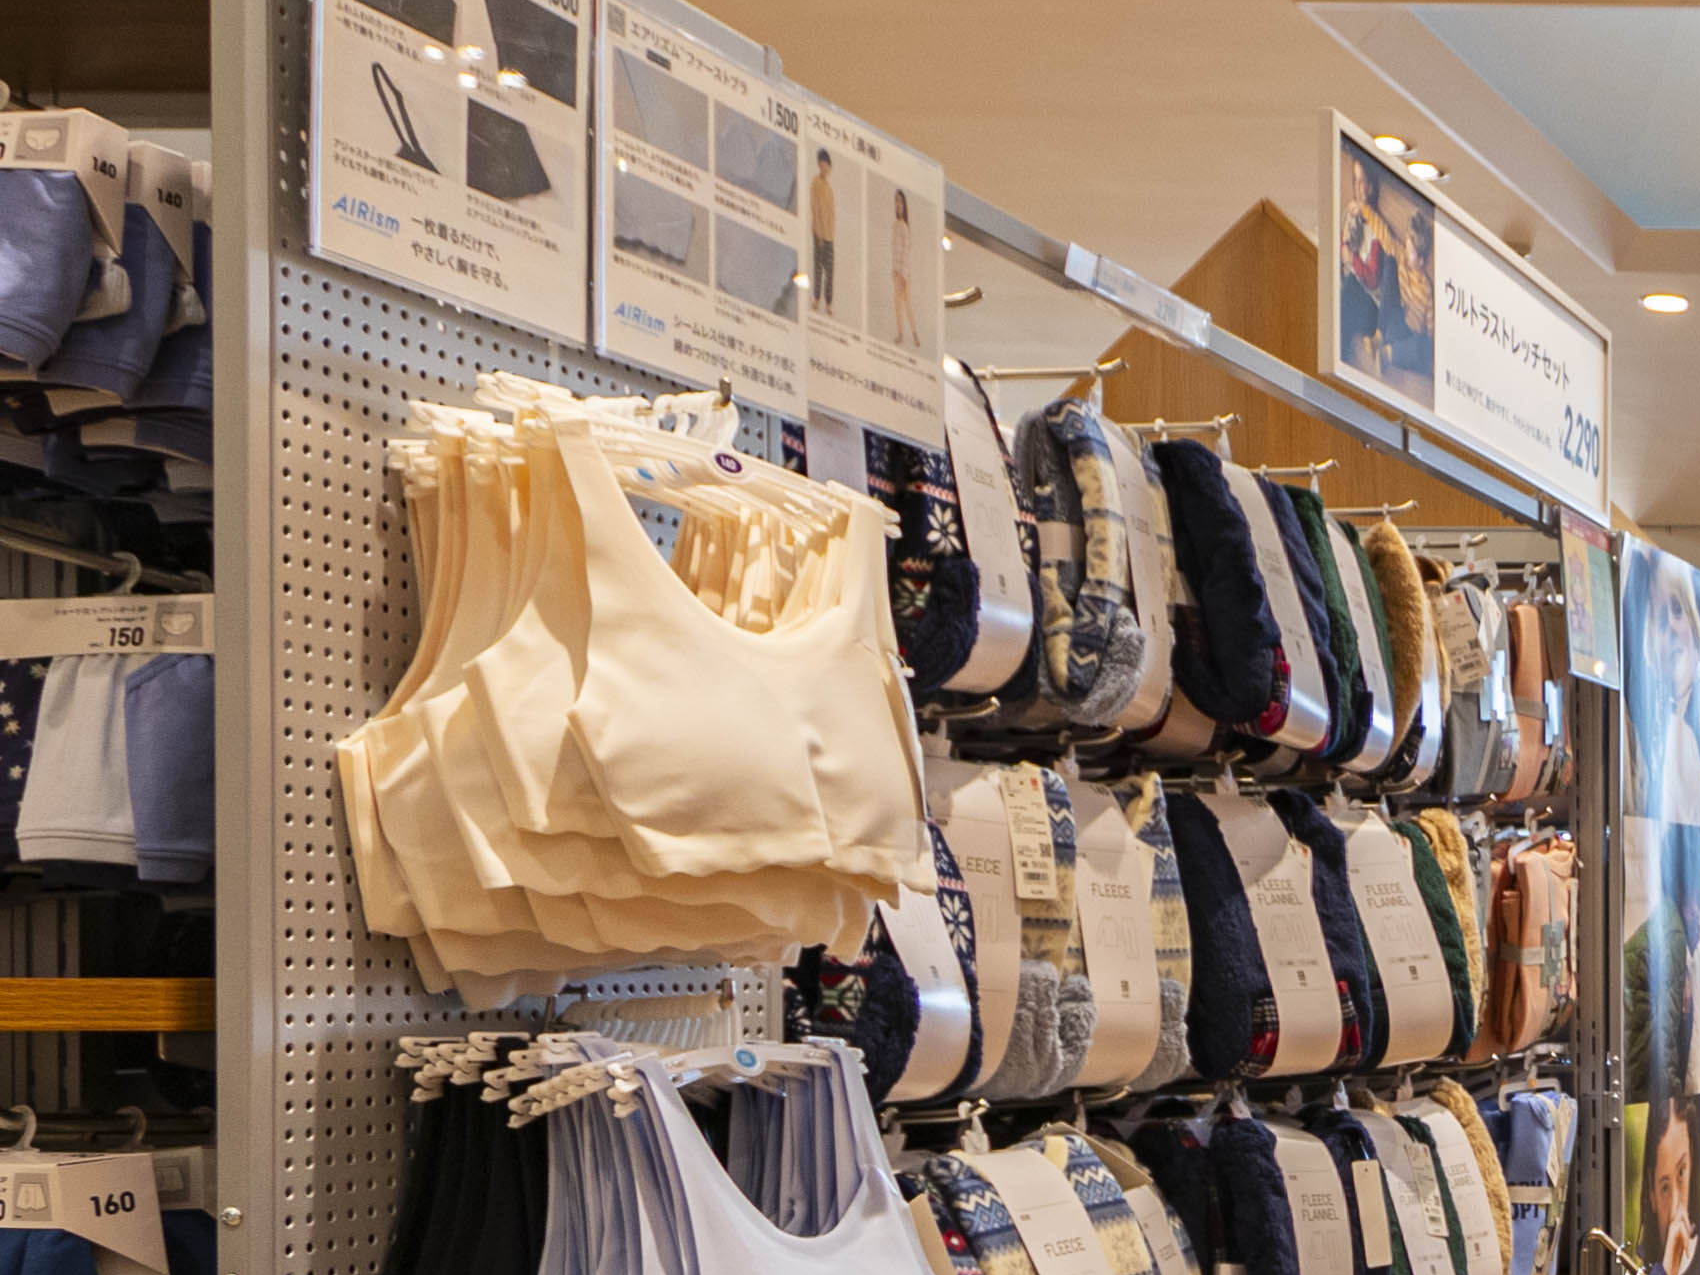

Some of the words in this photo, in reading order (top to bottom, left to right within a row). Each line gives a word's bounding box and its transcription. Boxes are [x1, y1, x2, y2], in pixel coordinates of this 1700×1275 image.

[92, 156, 117, 179] 140
[157, 187, 183, 209] 140
[332, 193, 400, 234] AIRism
[1445, 278, 1570, 392] ウルトラストレッチセット
[1558, 404, 1600, 478] ¥2,290
[109, 627, 144, 646] 150
[957, 855, 1000, 876] LEECE
[1091, 883, 1130, 899] FLEECE
[90, 1191, 136, 1217] 160
